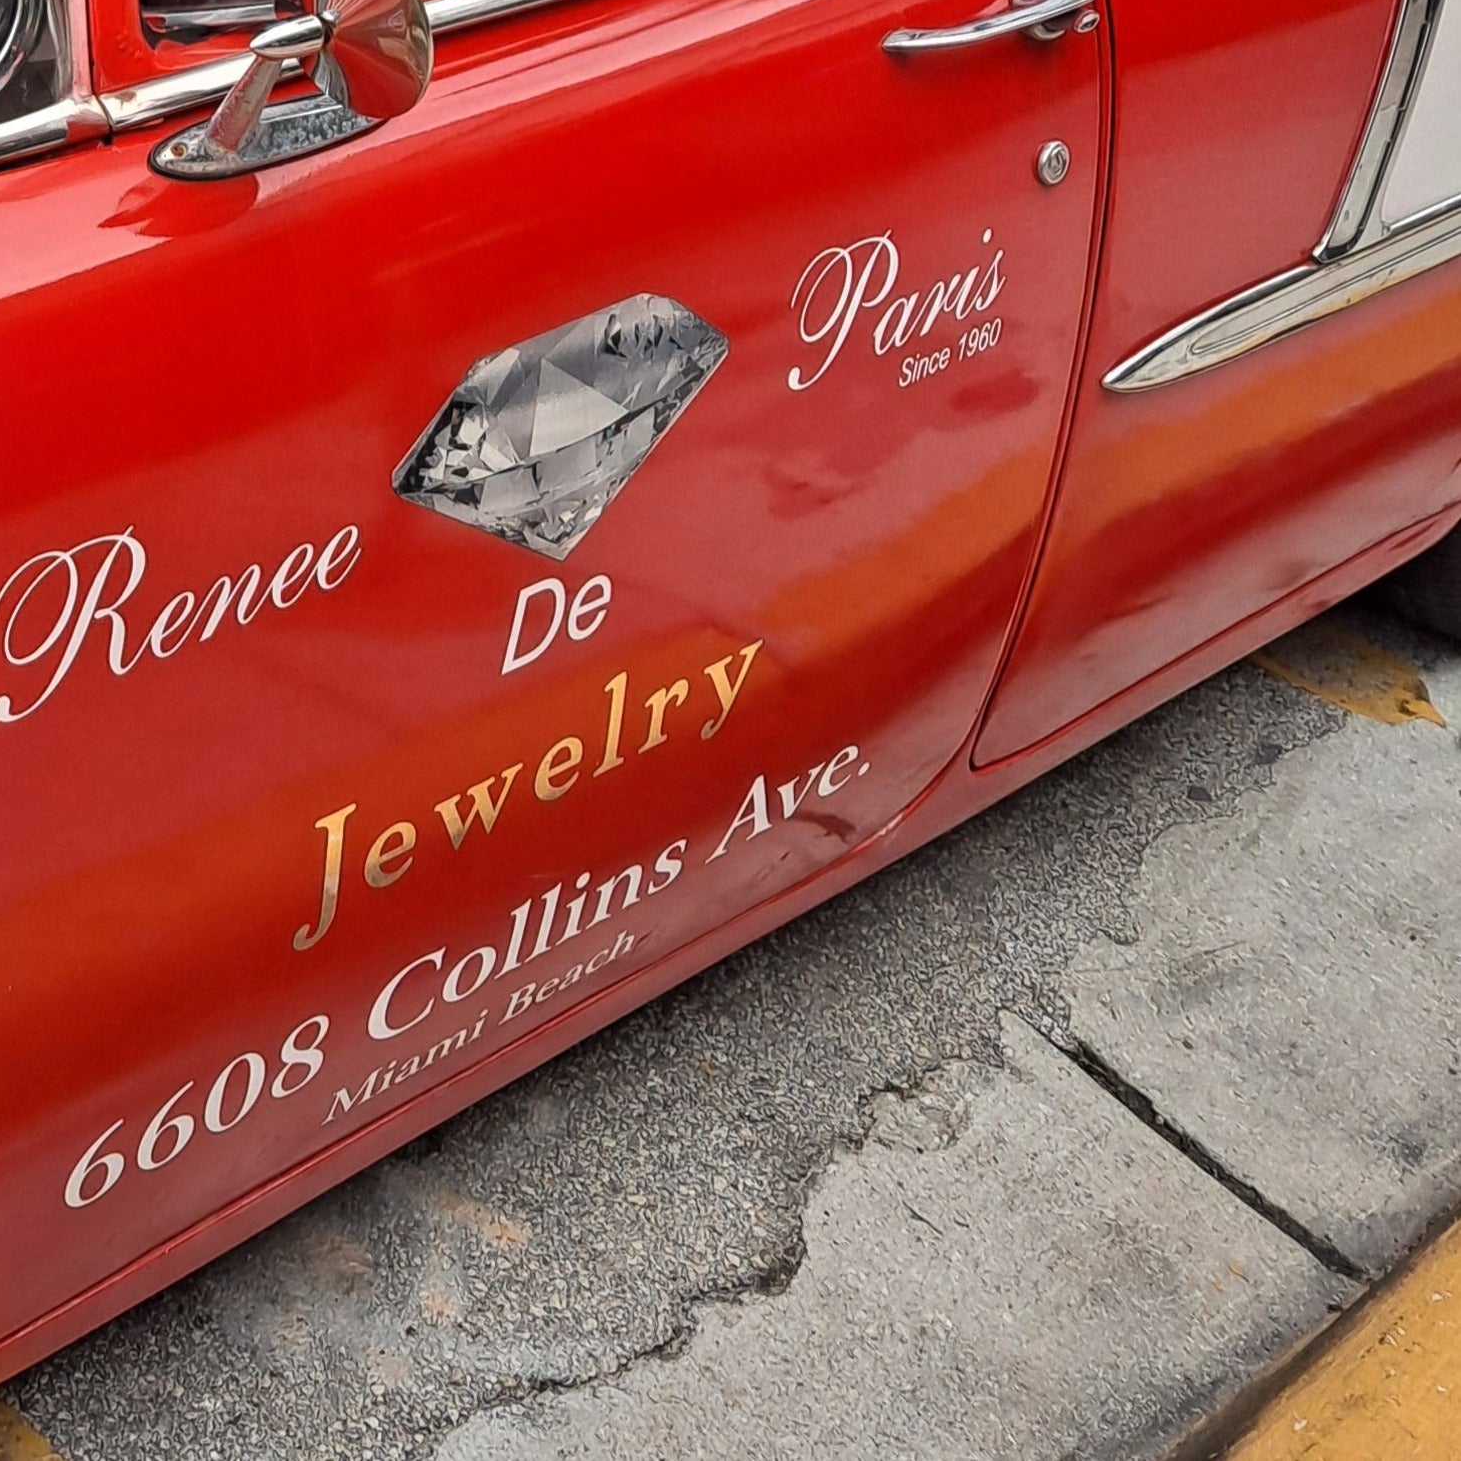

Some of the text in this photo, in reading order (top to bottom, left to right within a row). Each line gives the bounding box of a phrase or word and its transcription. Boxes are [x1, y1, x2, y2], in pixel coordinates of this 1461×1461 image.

[787, 228, 1007, 391] Paris
[898, 317, 1003, 388] Since 1960
[500, 573, 612, 676] De
[292, 638, 764, 952] Jewelry
[63, 744, 871, 1209] 6608 Collins Ave.
[321, 929, 637, 1126] Miami Beach
